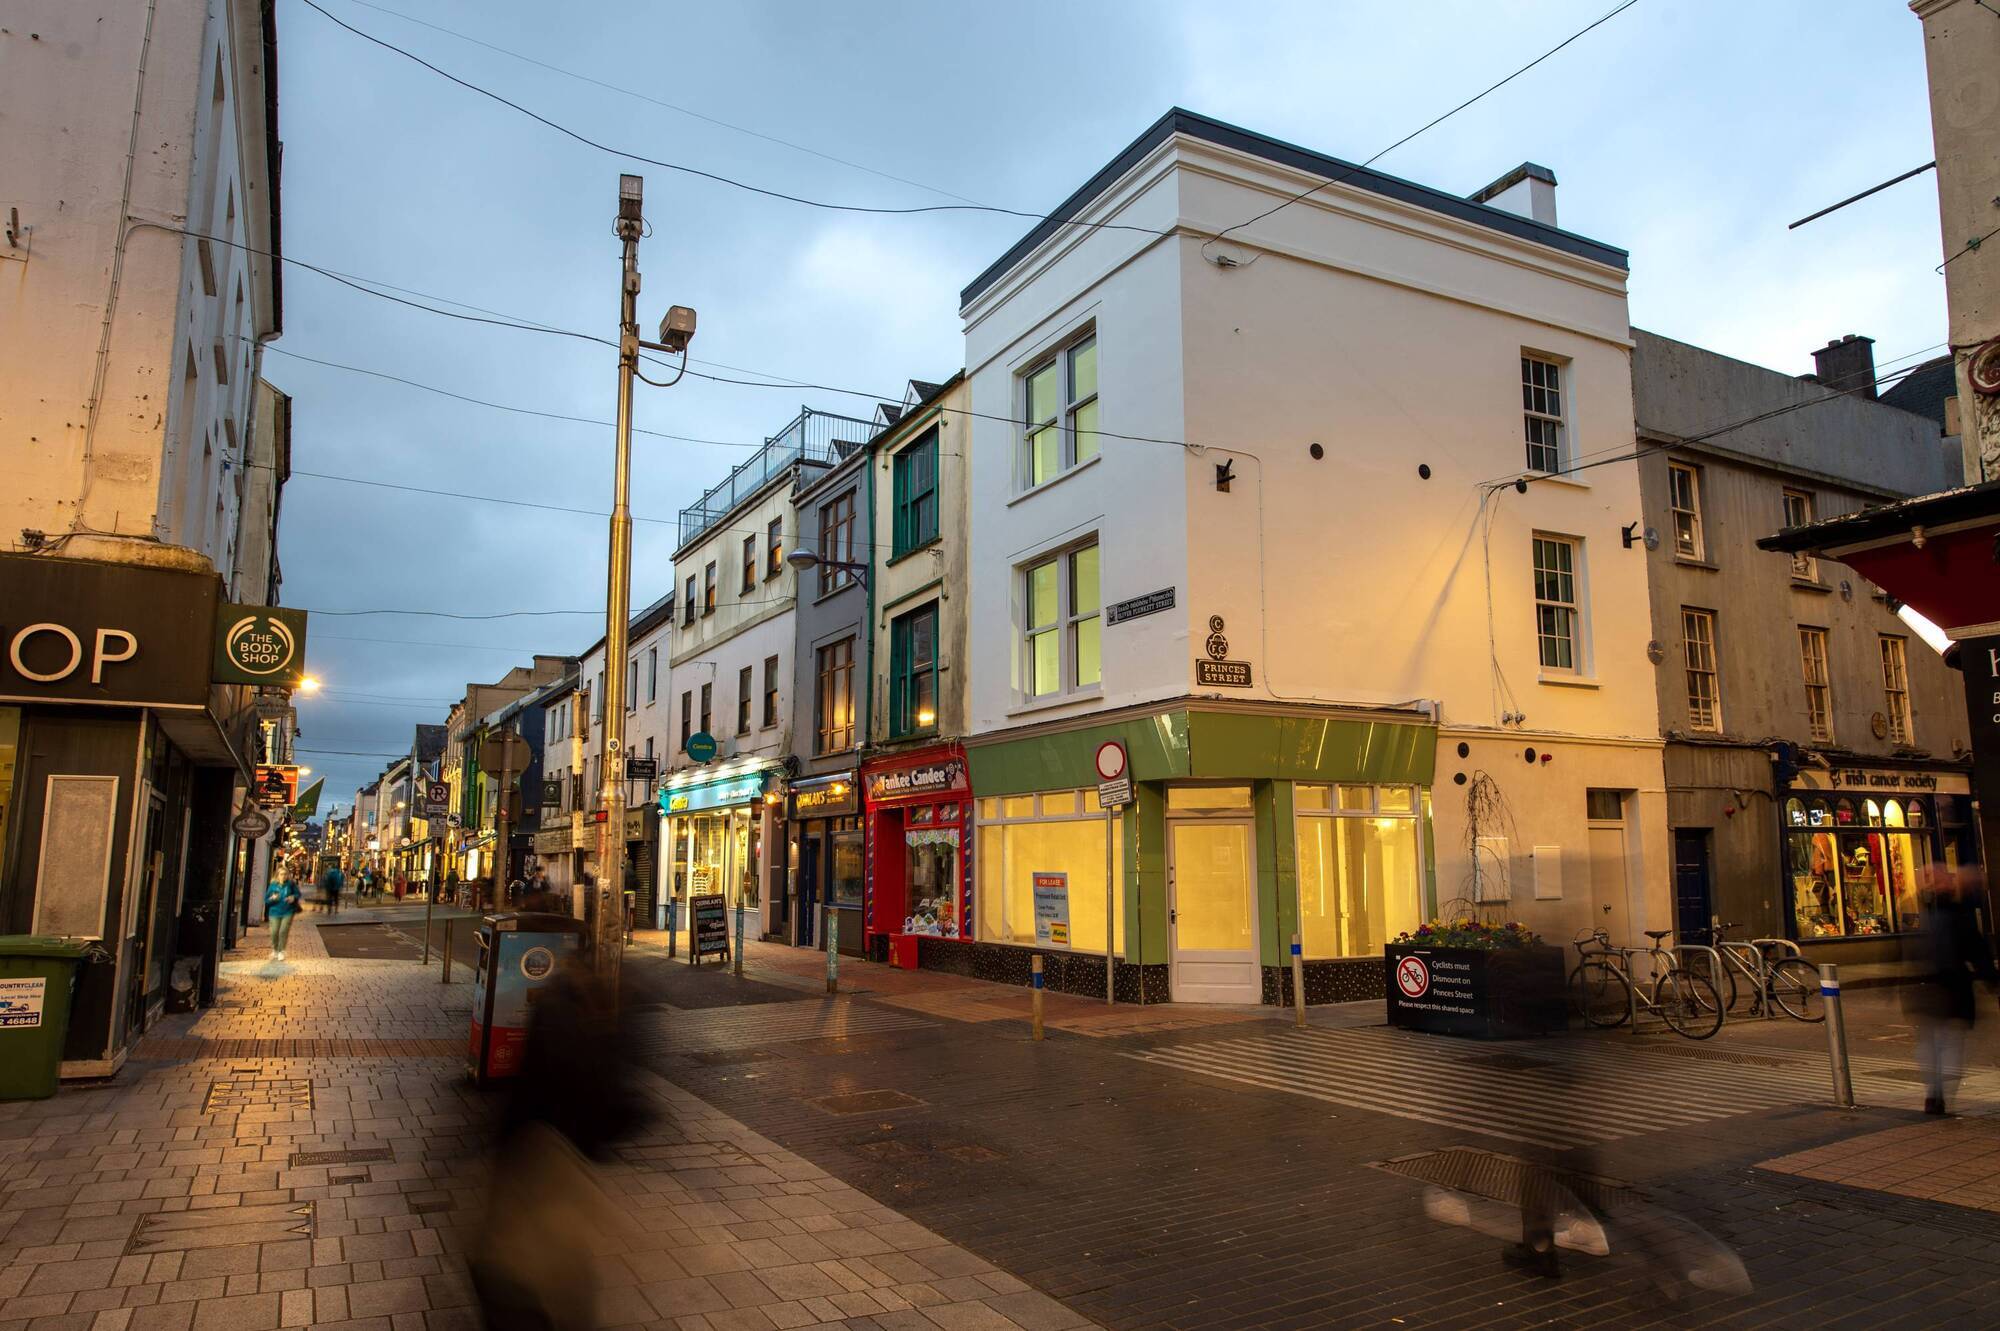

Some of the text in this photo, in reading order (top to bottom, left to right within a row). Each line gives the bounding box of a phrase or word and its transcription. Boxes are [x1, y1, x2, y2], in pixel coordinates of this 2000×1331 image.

[1155, 598, 1172, 609] STREET
[249, 633, 273, 643] THE
[240, 642, 282, 654] BODY
[242, 653, 279, 664] SHOP
[1204, 664, 1246, 674] PRINCES
[1205, 673, 1246, 683] STREET
[879, 773, 911, 791] Yankee
[911, 768, 946, 785] Candee
[1846, 770, 1937, 791] irish cancer society
[1432, 960, 1470, 971] Cyclists must
[1432, 974, 1461, 984] Dismount
[1433, 988, 1474, 999] Princes Street
[1398, 1000, 1475, 1015] Please respect this shared space
[7, 1016, 38, 1025] 46848
